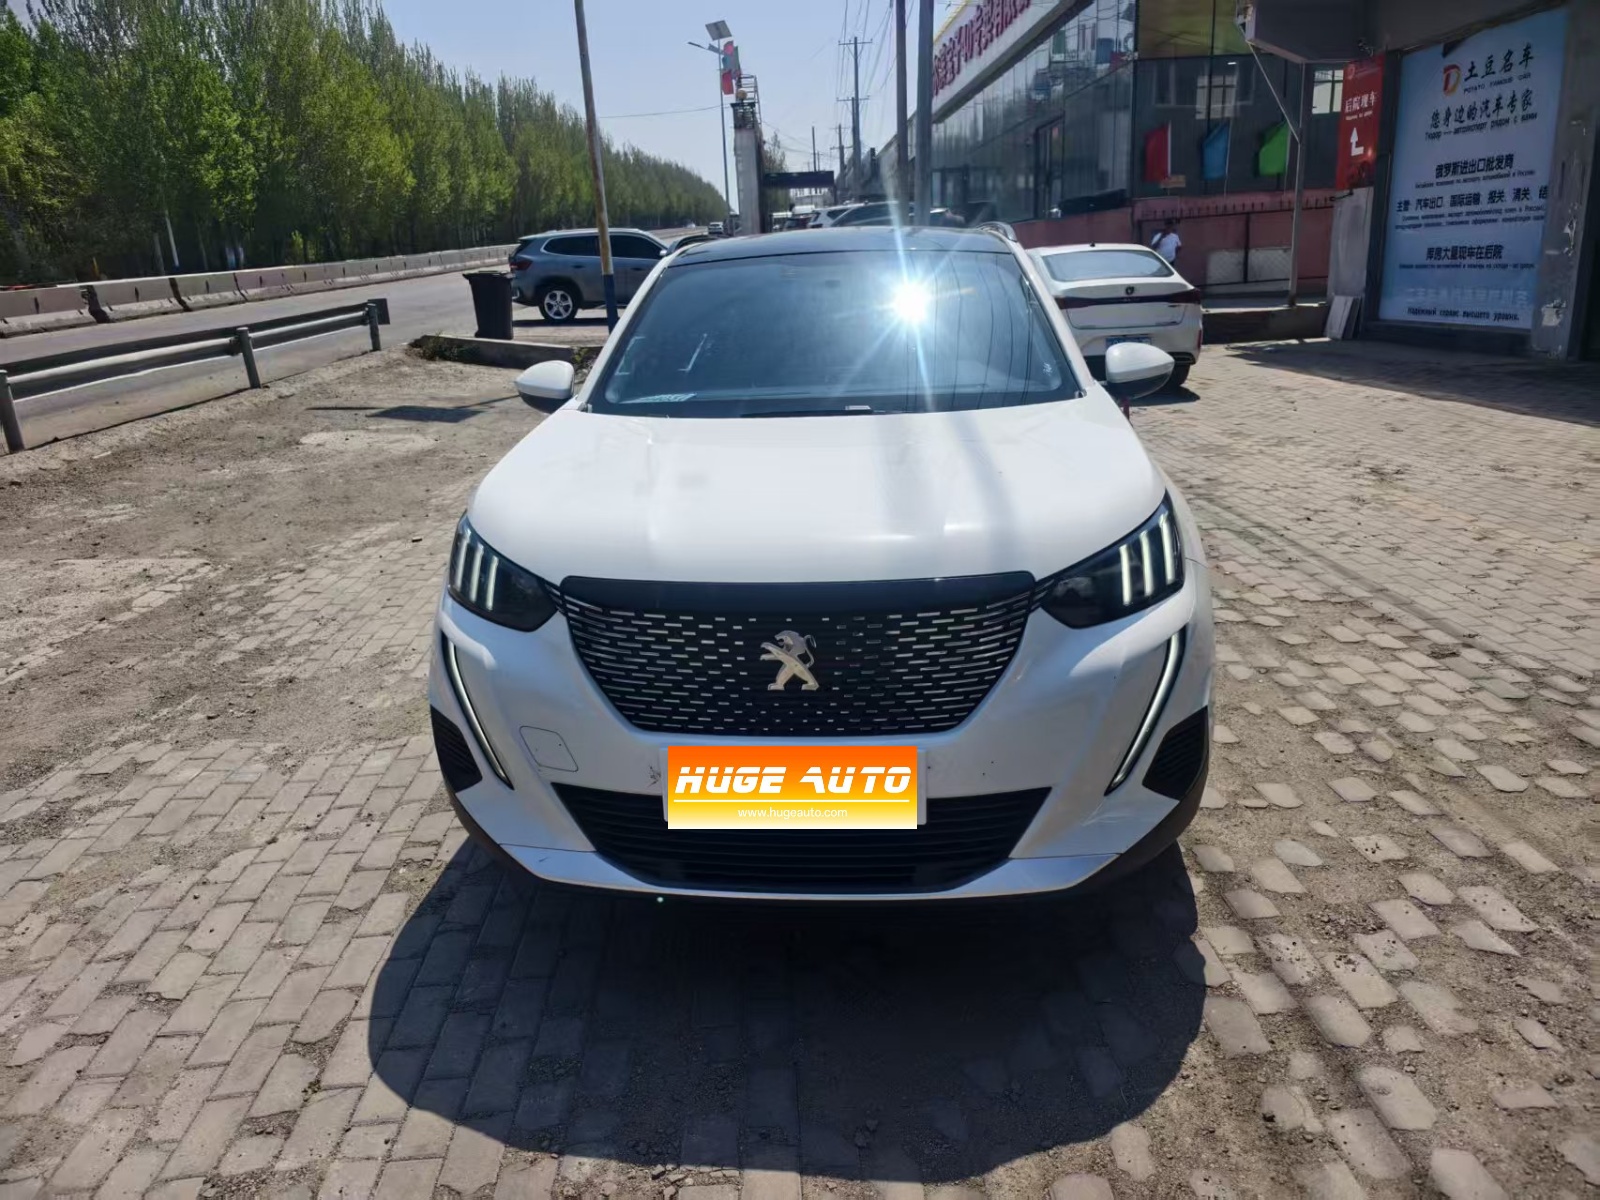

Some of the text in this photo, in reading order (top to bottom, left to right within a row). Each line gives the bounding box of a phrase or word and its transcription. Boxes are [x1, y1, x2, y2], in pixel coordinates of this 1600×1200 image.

[1464, 43, 1534, 82] 土豆名车
[1430, 89, 1534, 130] 您身边的汽车专家
[1435, 153, 1514, 180] 俄罗斯进出口批发商
[1415, 196, 1444, 212] 汽车出口
[1450, 191, 1481, 208] 国际运输
[1487, 189, 1505, 204] 报关
[1513, 187, 1531, 202] 清关
[1426, 244, 1504, 261] 库房大量现车在后院
